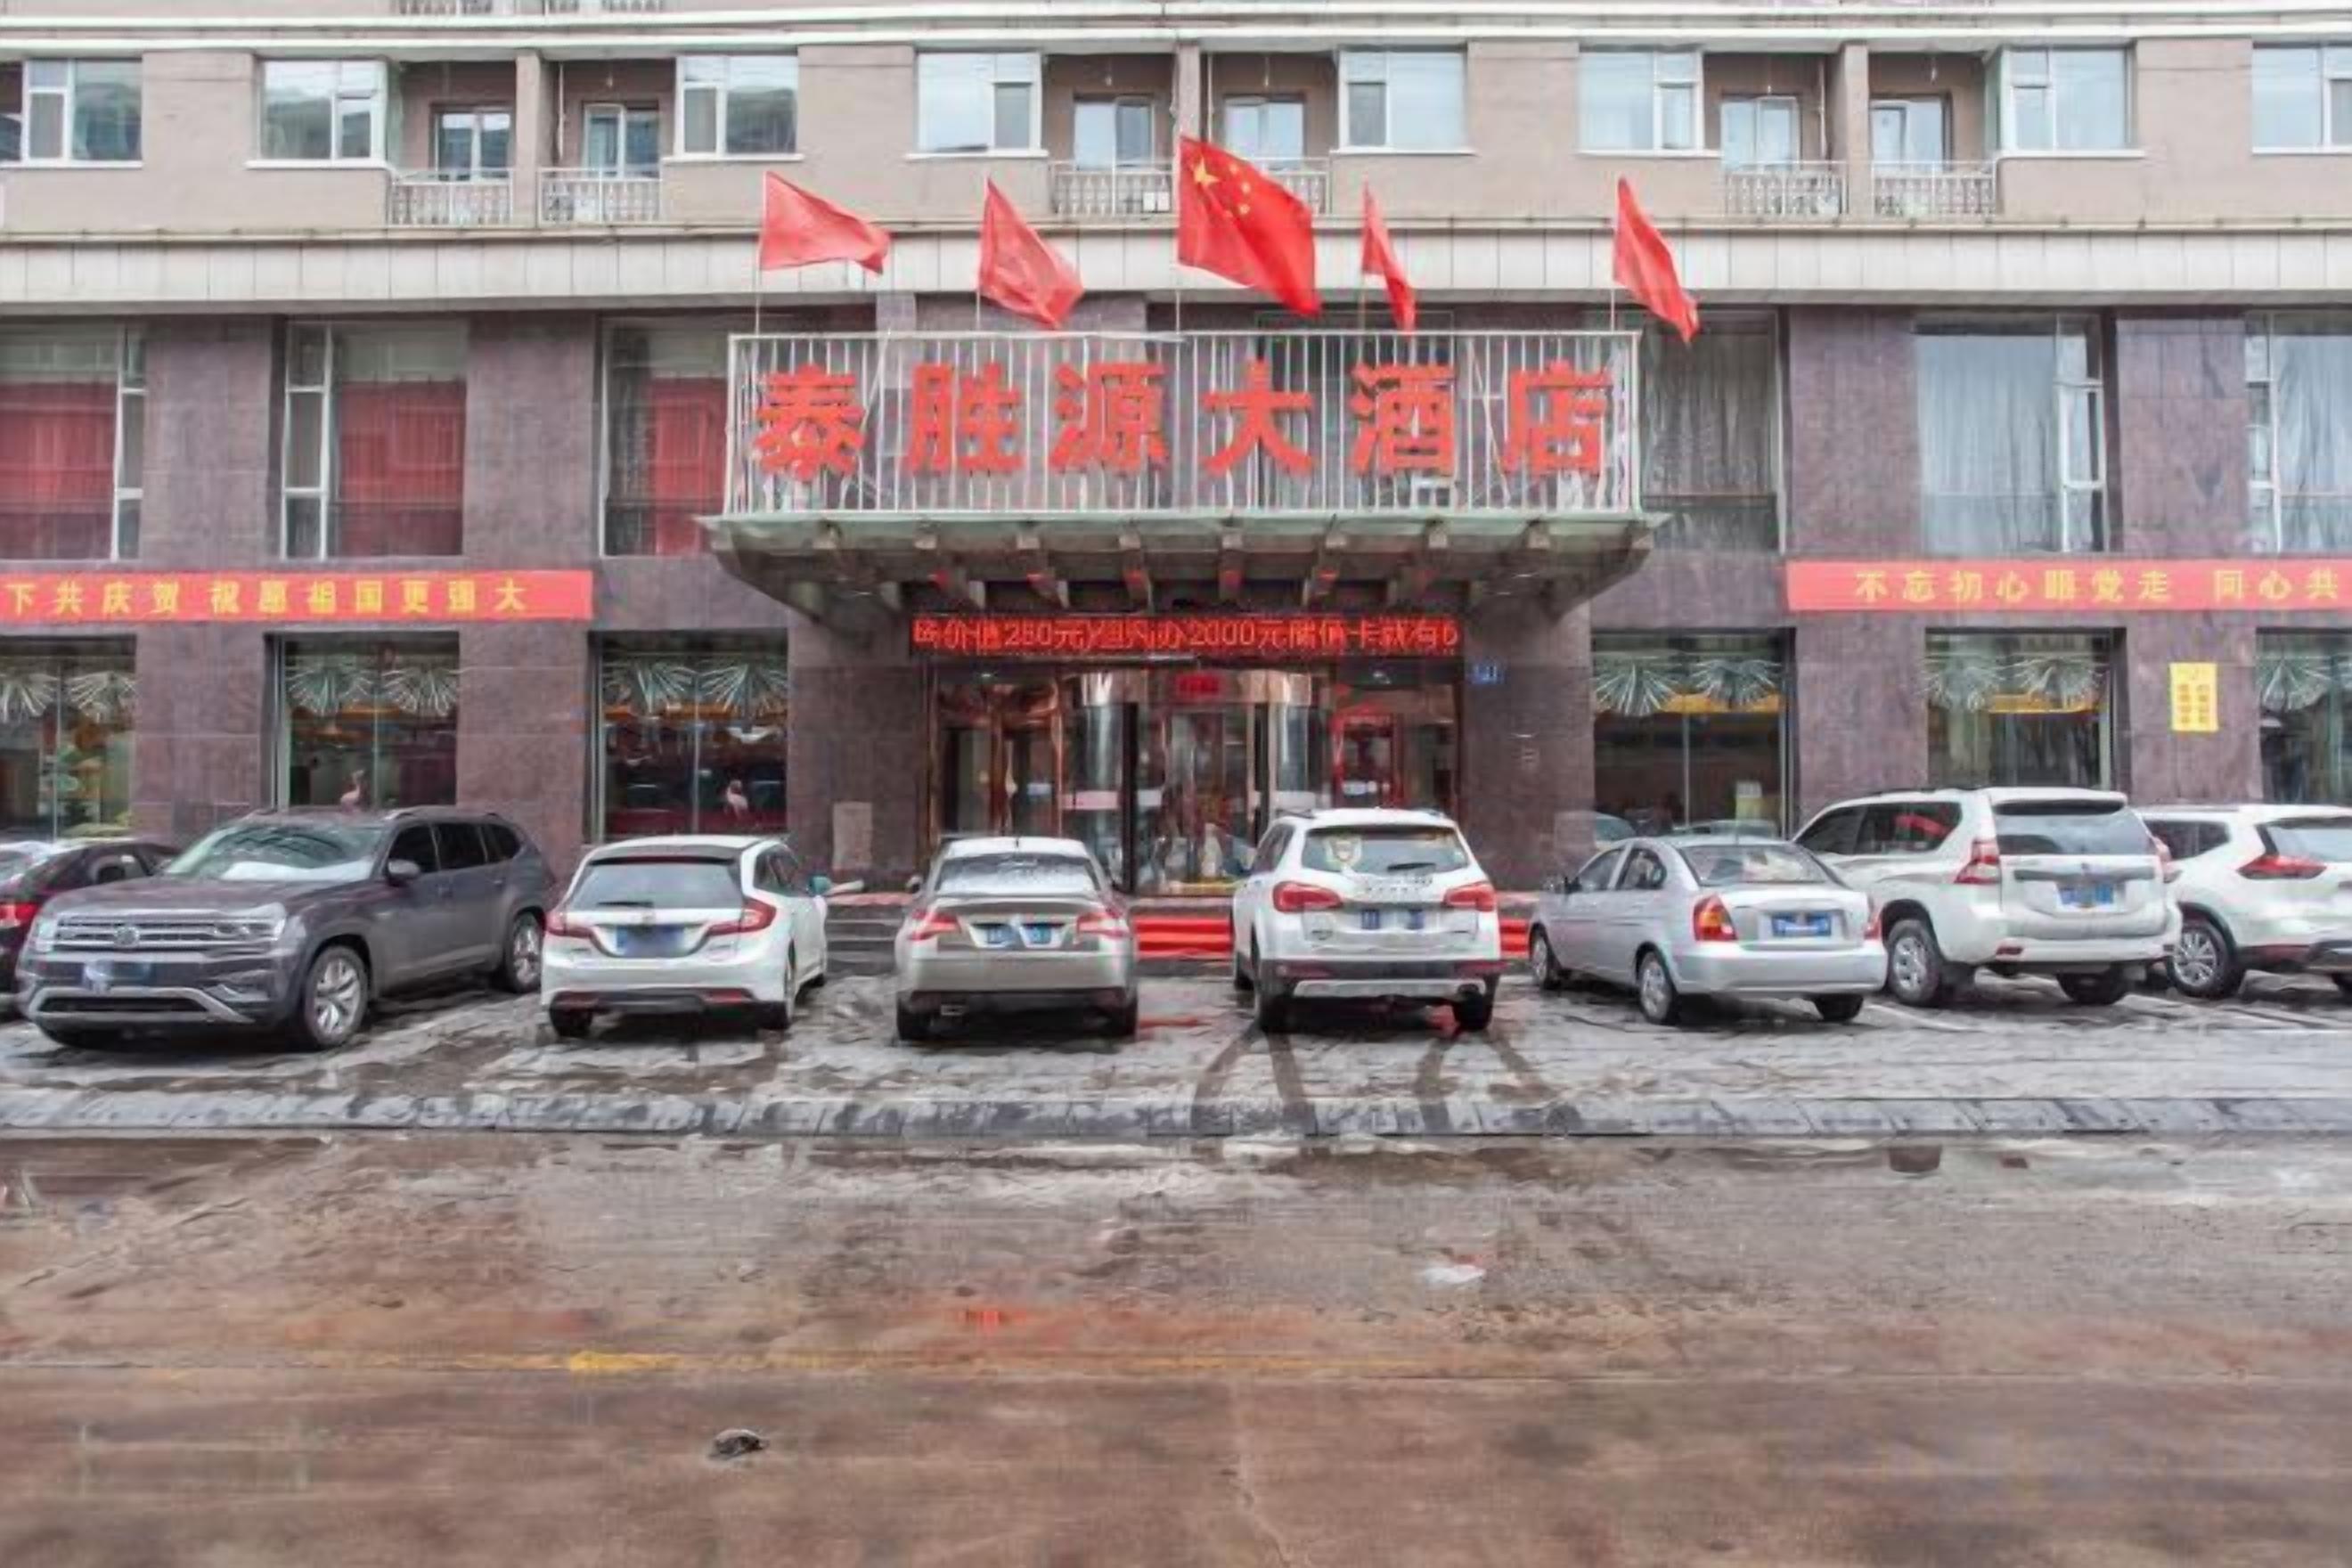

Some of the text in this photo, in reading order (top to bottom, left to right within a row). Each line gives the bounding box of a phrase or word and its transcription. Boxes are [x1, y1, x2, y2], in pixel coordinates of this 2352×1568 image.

[754, 357, 1611, 481] 泰胜源大酒店
